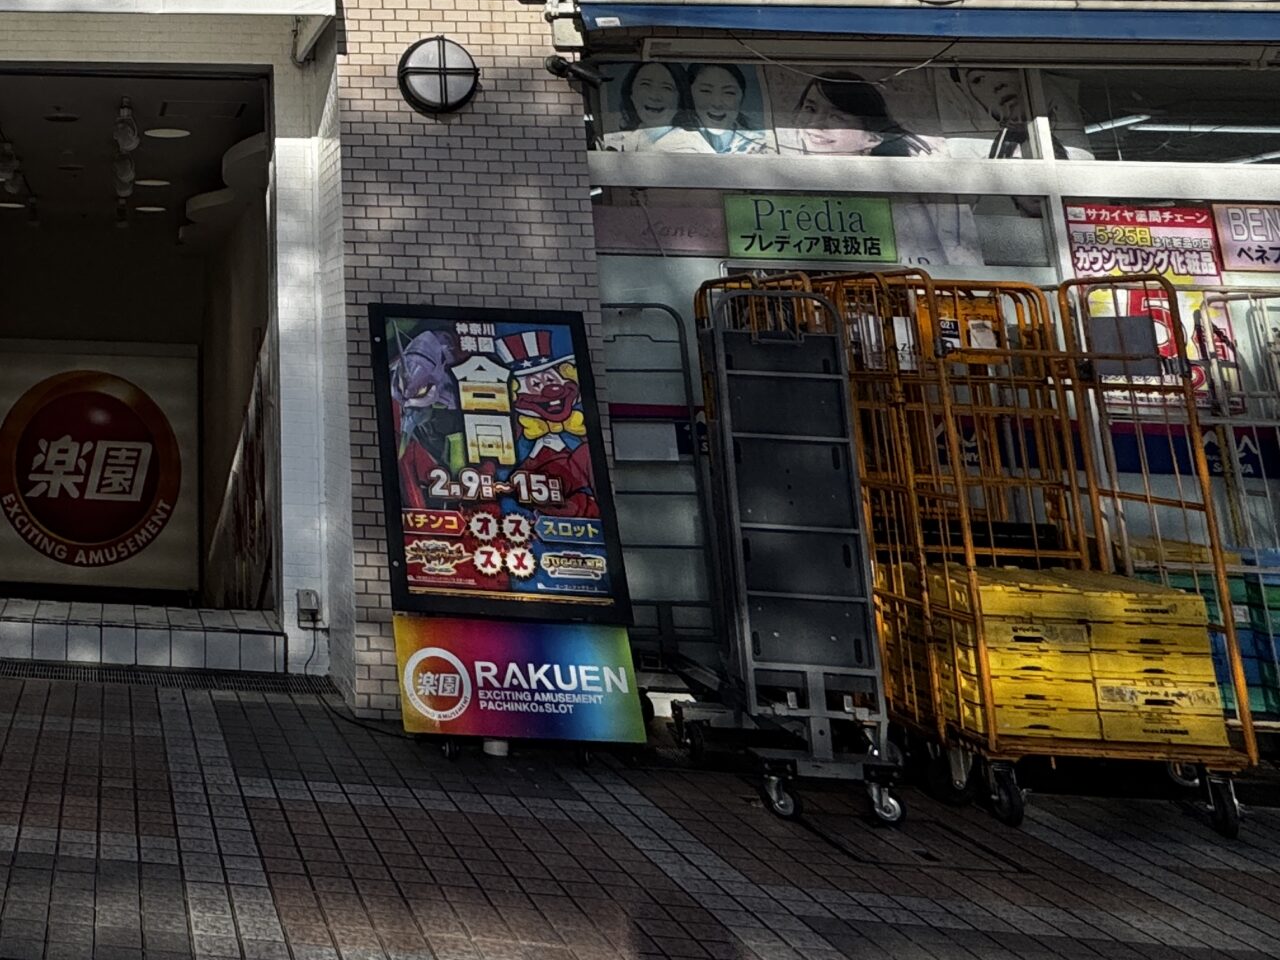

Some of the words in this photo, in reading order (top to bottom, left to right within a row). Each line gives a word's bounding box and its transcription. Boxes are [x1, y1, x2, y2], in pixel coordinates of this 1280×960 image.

[750, 198, 867, 233] Prédia
[1086, 208, 1209, 225] サカイヤ薬局チェーン
[451, 355, 517, 466] 合同
[24, 434, 153, 502] 楽園
[2, 492, 69, 560] EXCITING
[74, 498, 172, 565] AMUSEMENT
[542, 520, 600, 538] スロット
[417, 672, 460, 697] 楽園
[474, 660, 629, 694] RAKUEN
[478, 690, 532, 702] EXCITING
[533, 691, 604, 704] AMUSEMENT
[479, 700, 574, 714] PACHINKO&SLOT
